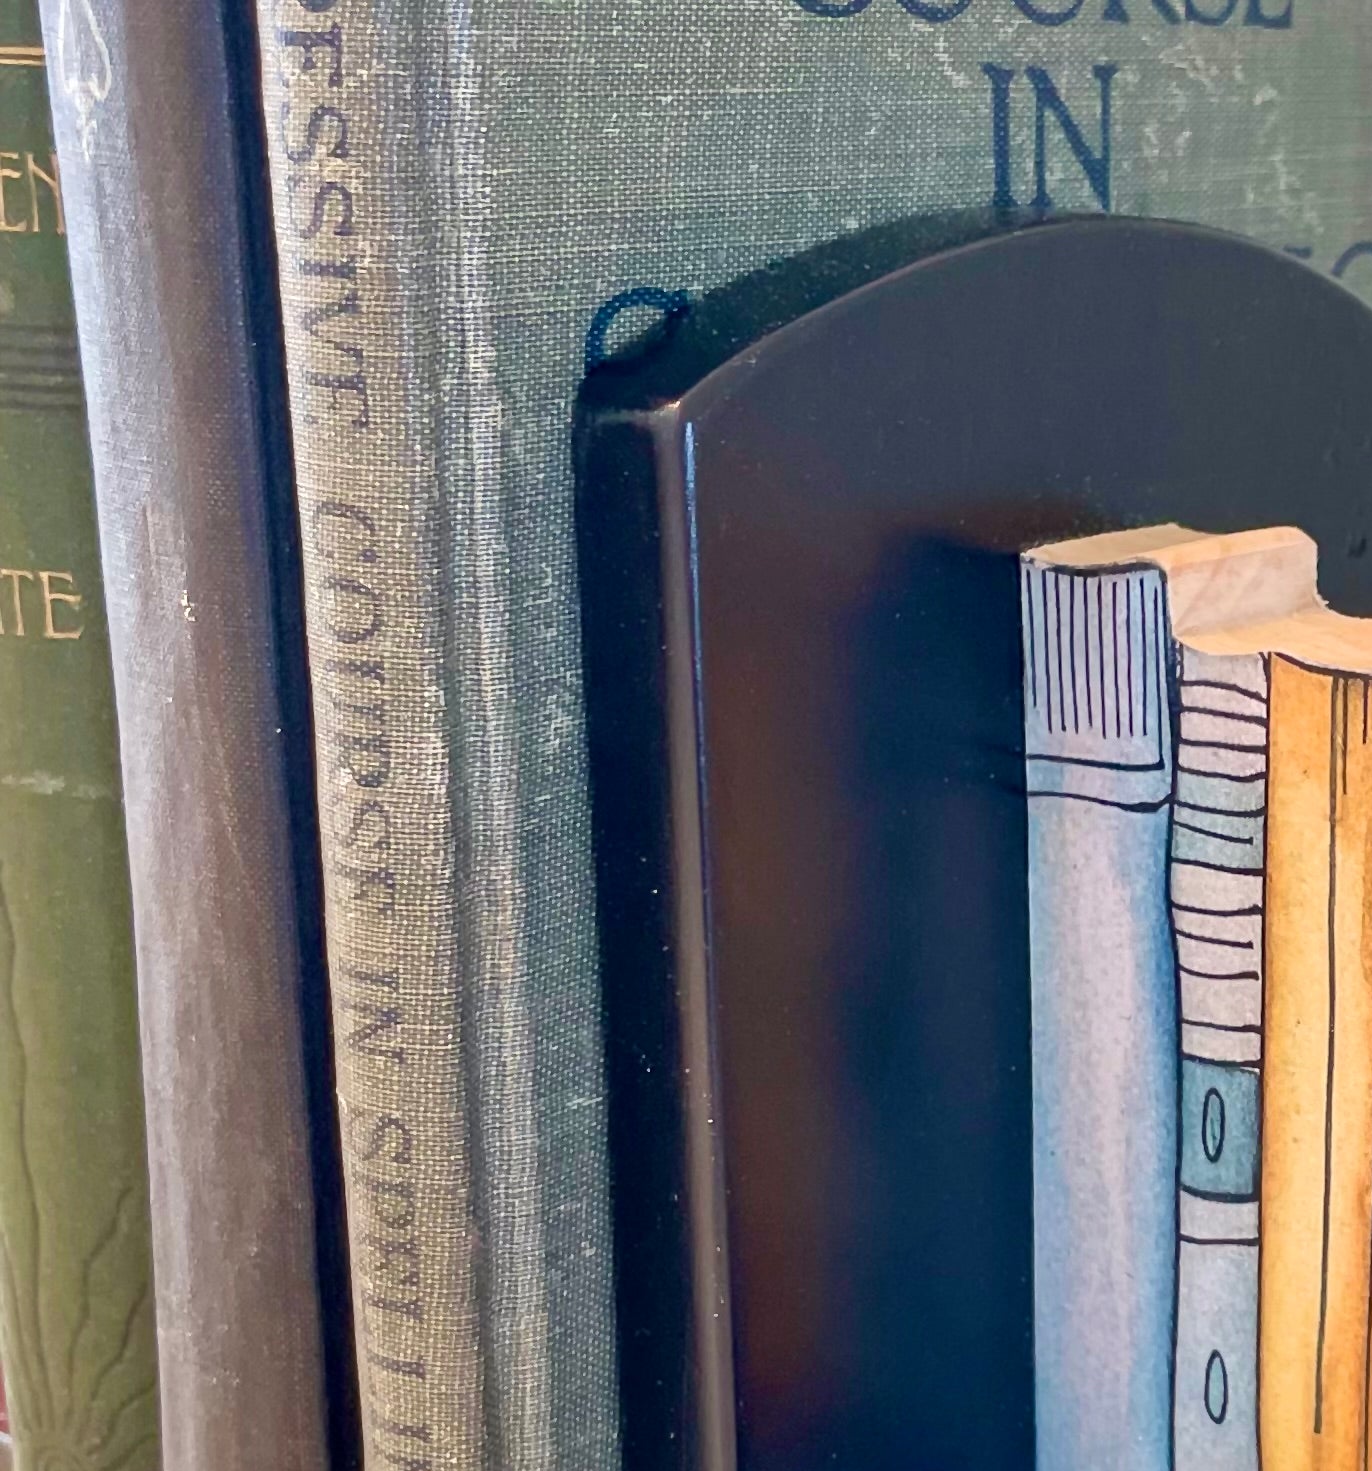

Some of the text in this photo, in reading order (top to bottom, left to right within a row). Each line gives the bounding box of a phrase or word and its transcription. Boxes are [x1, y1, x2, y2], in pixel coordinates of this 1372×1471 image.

[978, 61, 1120, 213] IN
[273, 0, 371, 429] ESSIVE
[0, 568, 84, 640] TE
[311, 500, 397, 916] COURSE
[336, 962, 406, 1066] IN
